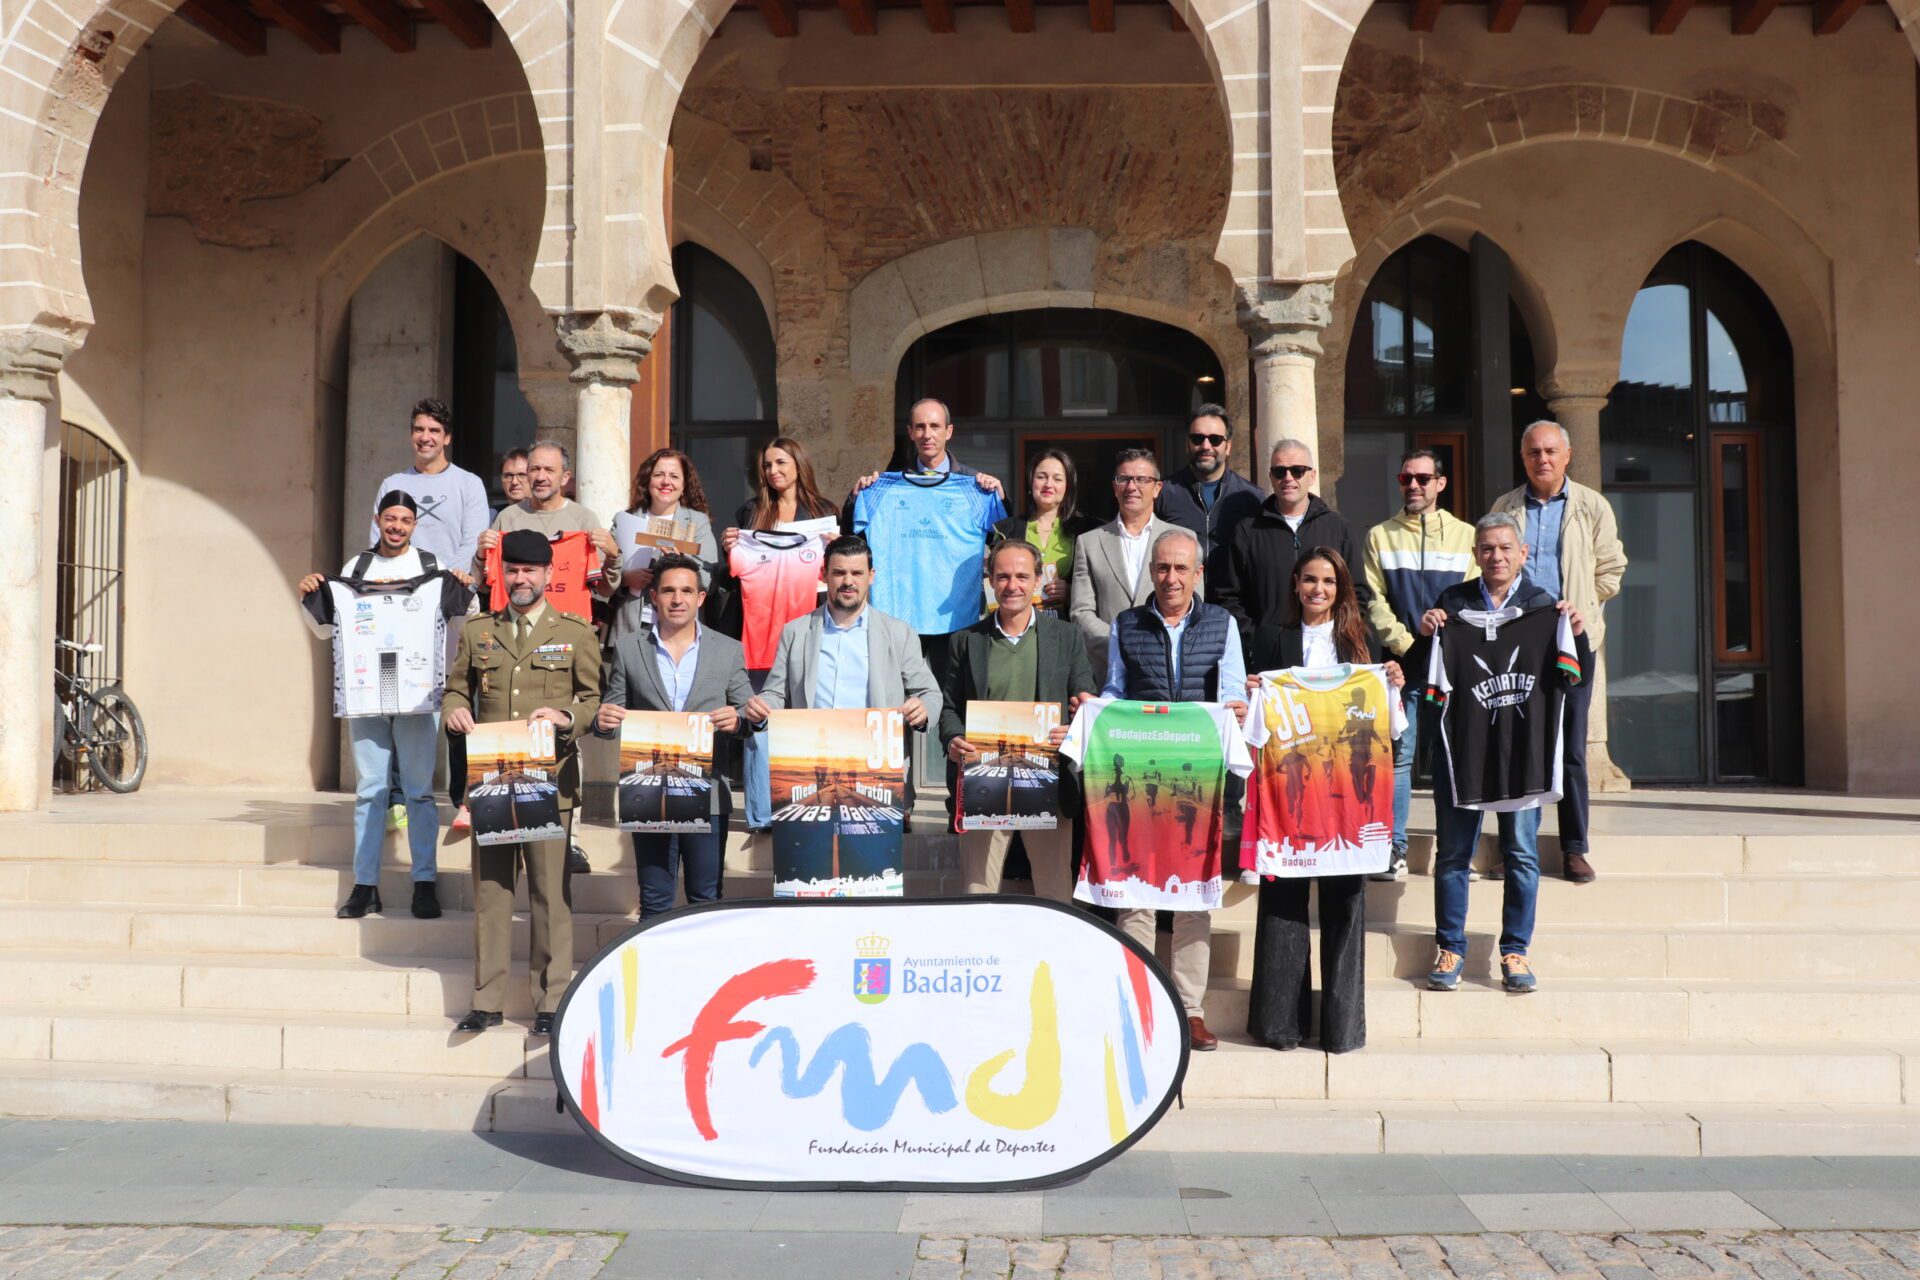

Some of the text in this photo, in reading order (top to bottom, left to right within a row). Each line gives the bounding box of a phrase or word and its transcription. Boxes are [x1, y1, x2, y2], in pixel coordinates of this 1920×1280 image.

[1471, 673, 1535, 702] KENIATAS
[1488, 692, 1524, 709] PACENSES
[866, 710, 904, 769] 36
[1109, 728, 1201, 743] #BadajozEsDeporte
[1282, 857, 1317, 868] Badajoz
[1101, 887, 1125, 898] Elvas
[903, 956, 1000, 968] Ayuntamiento de
[902, 969, 1002, 998] Badajoz
[808, 1139, 1056, 1158] Fundación Municipal de Deportes
